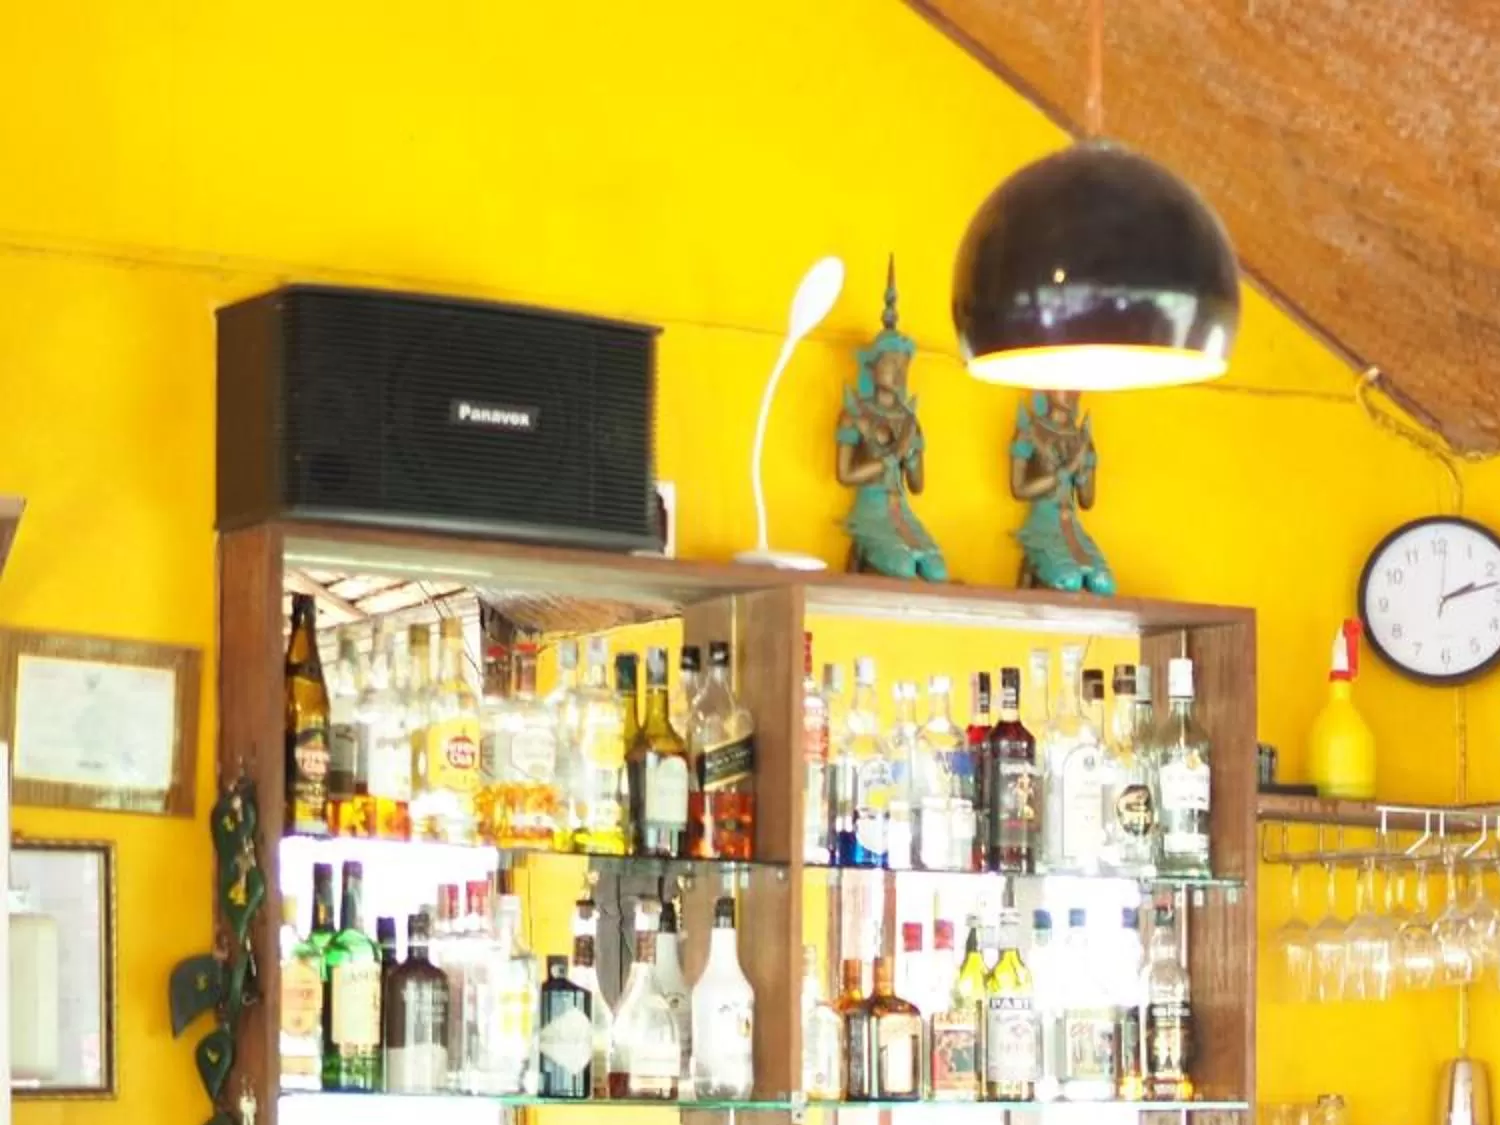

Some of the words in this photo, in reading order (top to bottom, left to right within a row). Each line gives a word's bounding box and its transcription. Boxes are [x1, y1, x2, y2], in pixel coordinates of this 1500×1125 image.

[458, 402, 530, 426] Panavox
[1406, 545, 1419, 564] 11
[1431, 538, 1448, 556] 12
[1387, 568, 1403, 584] 10
[1485, 561, 1497, 577] 2
[1378, 597, 1389, 613] 9
[1392, 623, 1403, 638] 8
[1488, 616, 1499, 631] 4
[1412, 641, 1423, 656] 7
[1440, 647, 1451, 665] 6
